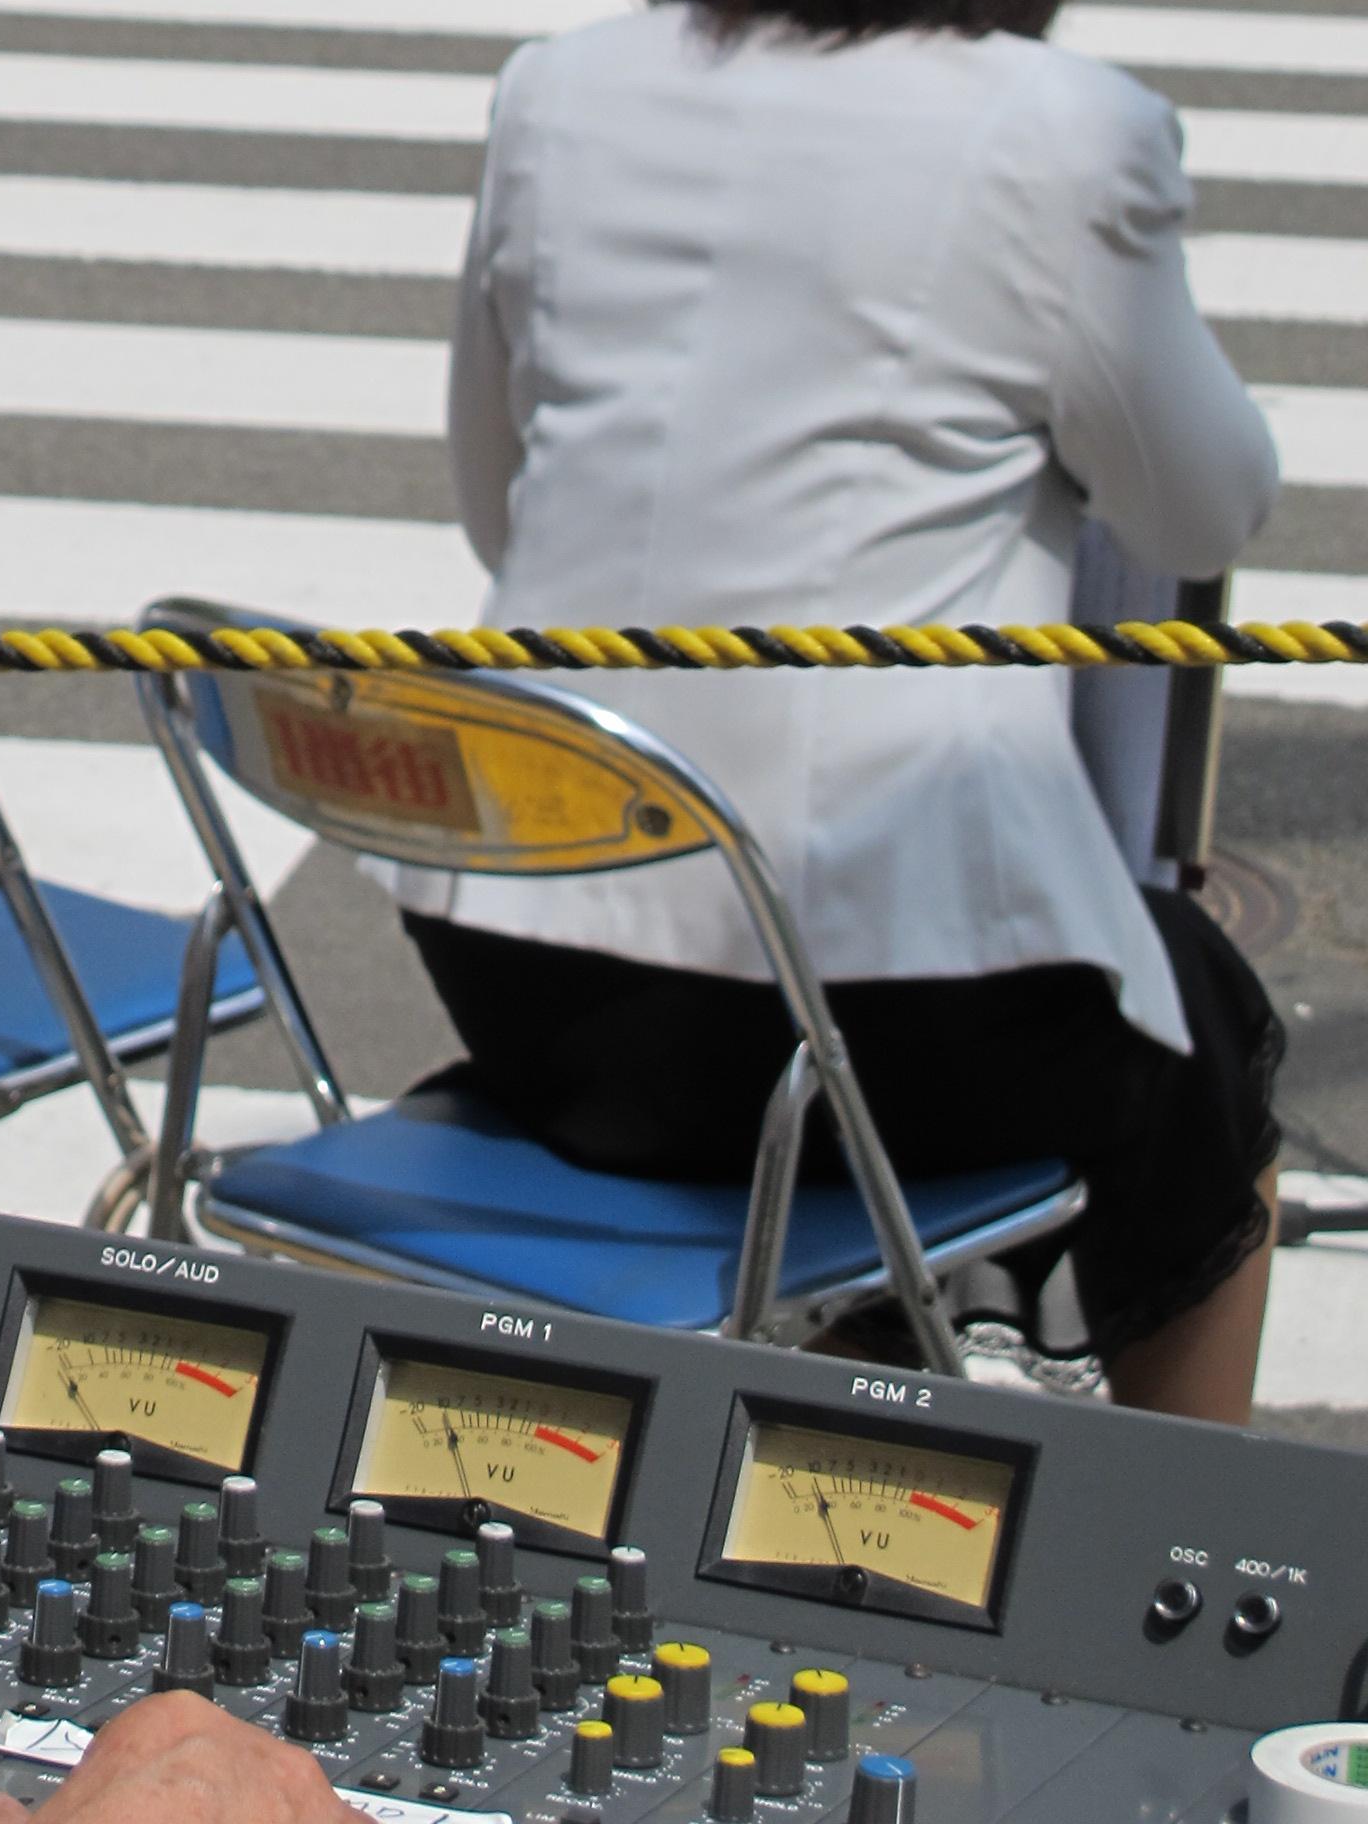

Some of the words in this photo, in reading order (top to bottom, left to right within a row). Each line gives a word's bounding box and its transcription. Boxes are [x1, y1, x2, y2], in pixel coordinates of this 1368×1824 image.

[100, 1246, 220, 1284] SOLO/AUD
[480, 1312, 535, 1339] PGM
[543, 1322, 553, 1341] 1
[851, 1377, 907, 1403] PGM
[915, 1388, 933, 1407] 2
[128, 1398, 157, 1417] VU
[487, 1463, 515, 1483] VU
[860, 1529, 890, 1550] VU
[1169, 1545, 1209, 1567] OSC
[1234, 1558, 1308, 1585] 400/1K
